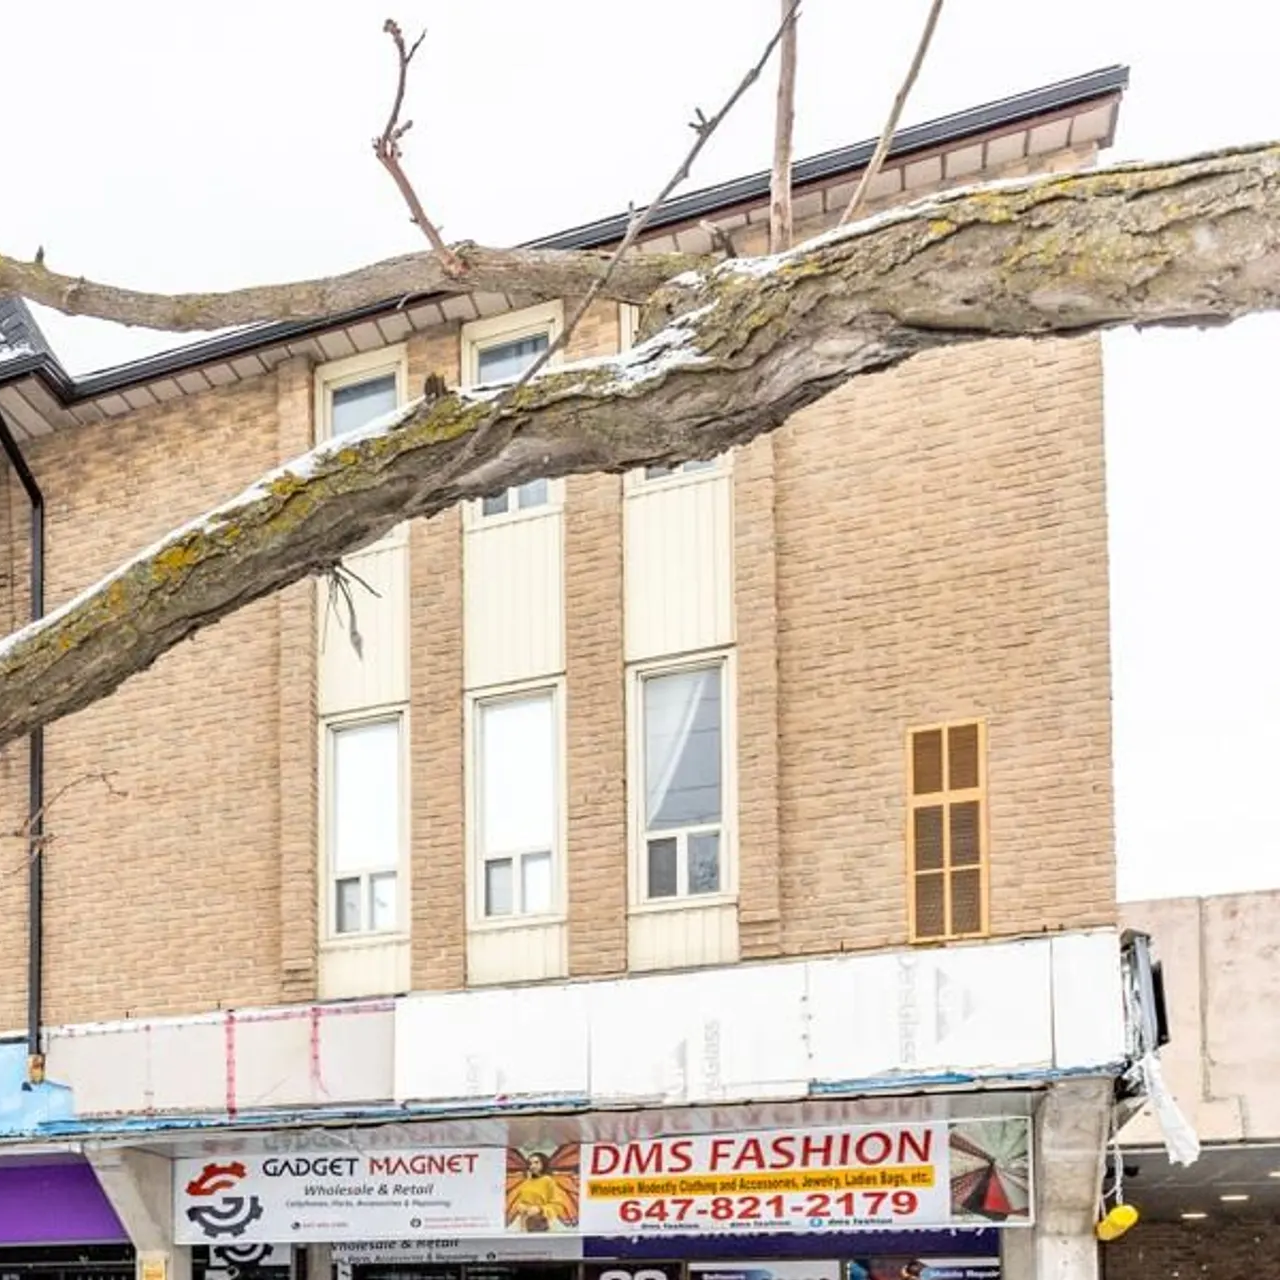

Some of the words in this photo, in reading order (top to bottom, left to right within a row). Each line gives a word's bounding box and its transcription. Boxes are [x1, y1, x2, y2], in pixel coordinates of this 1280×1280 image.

[590, 1140, 694, 1176] DMS
[710, 1128, 933, 1171] FASHION
[262, 1157, 359, 1177] GADGET
[369, 1153, 479, 1176] MAGNET
[303, 1184, 375, 1197] Wholesale
[377, 1184, 389, 1196] &
[392, 1183, 435, 1196] Retail
[719, 1178, 737, 1192] and
[845, 1172, 878, 1186] Ladies
[881, 1170, 908, 1187] Bags,
[619, 1190, 918, 1222] 647-821-2179
